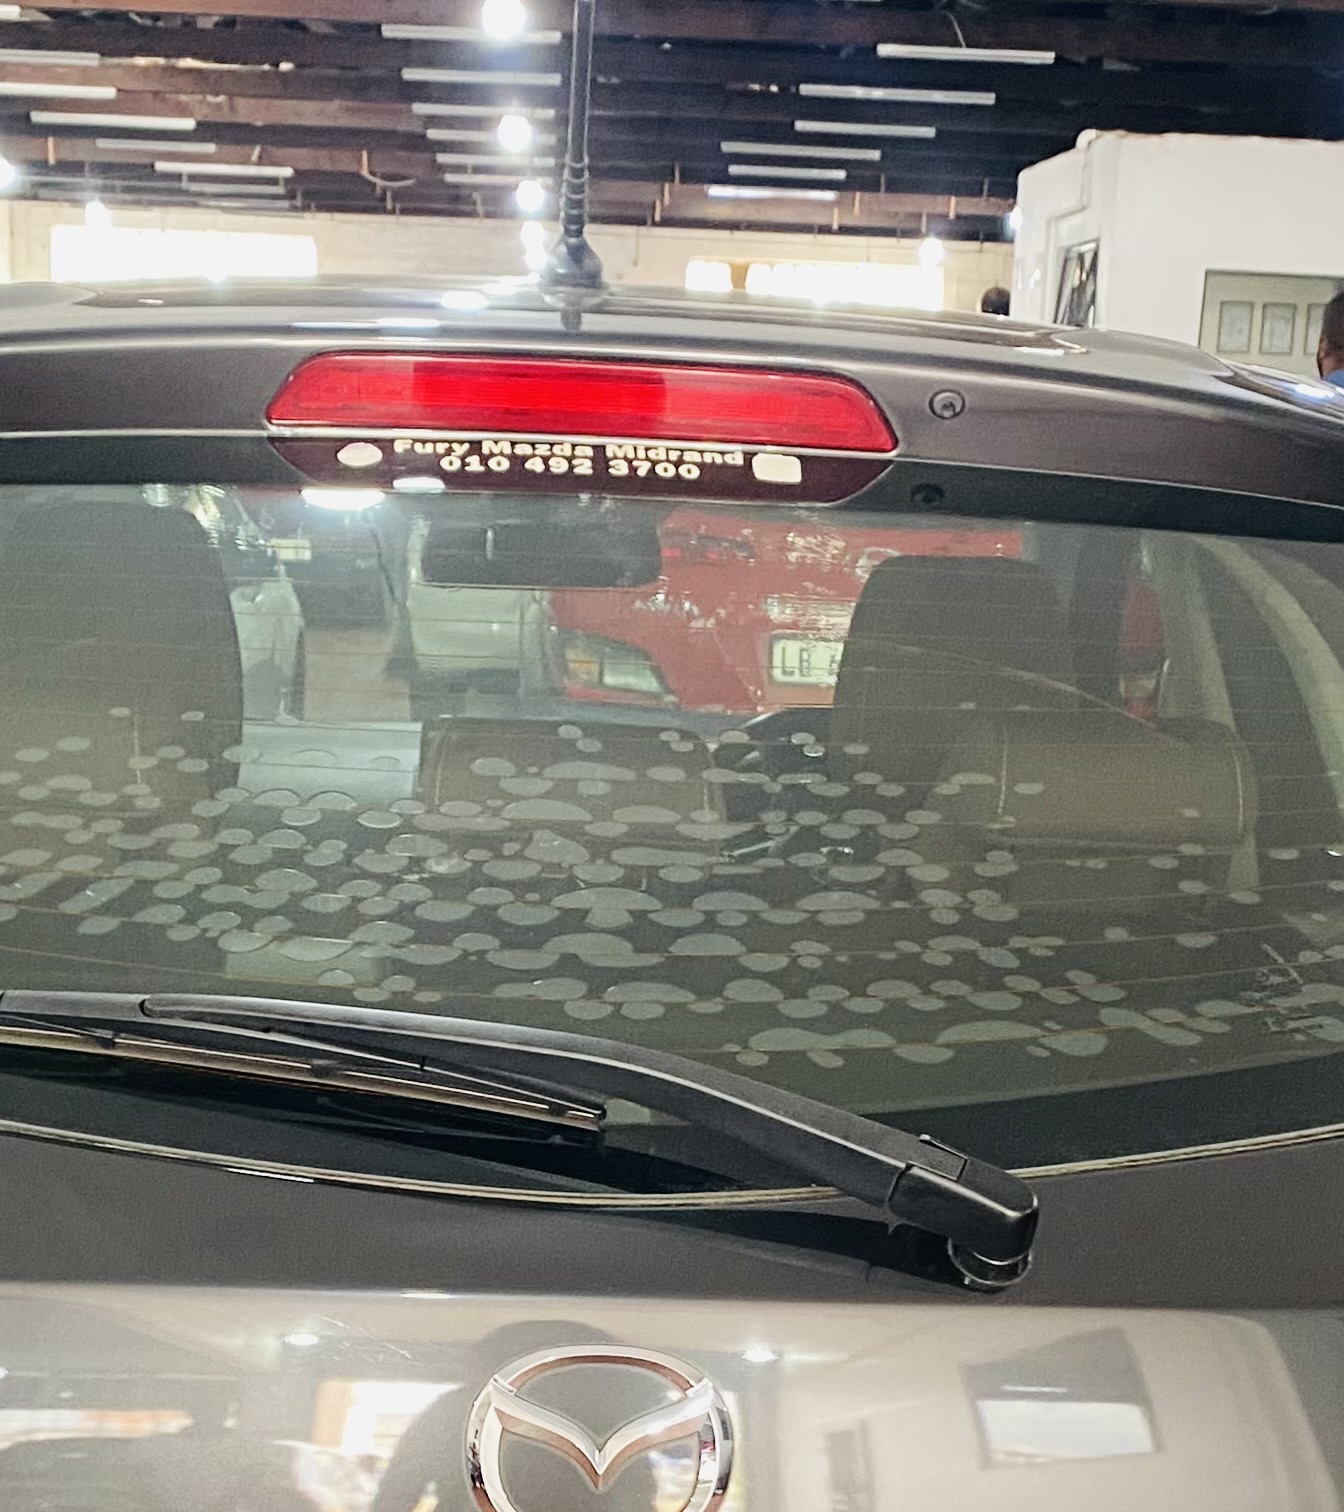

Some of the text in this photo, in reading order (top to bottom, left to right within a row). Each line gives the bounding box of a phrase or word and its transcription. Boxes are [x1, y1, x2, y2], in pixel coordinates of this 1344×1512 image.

[393, 438, 744, 466] Fury Mazda Midrand
[439, 455, 701, 480] 010 492 3700
